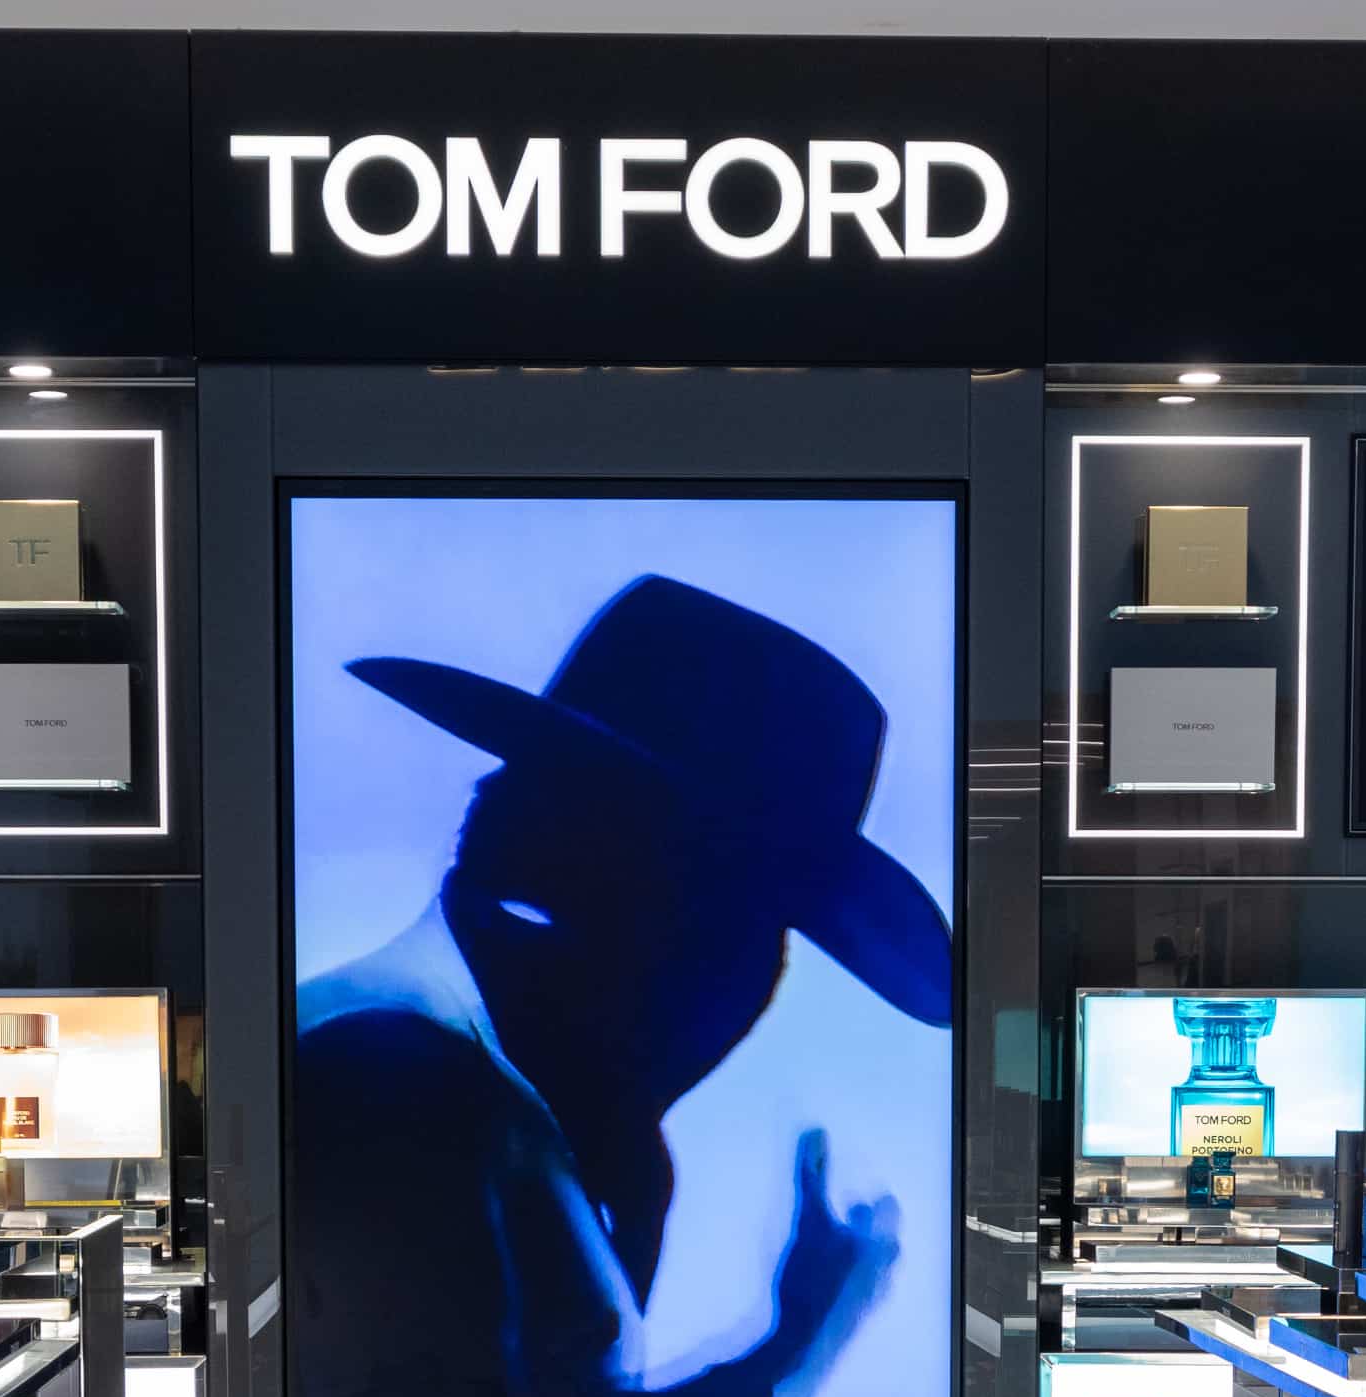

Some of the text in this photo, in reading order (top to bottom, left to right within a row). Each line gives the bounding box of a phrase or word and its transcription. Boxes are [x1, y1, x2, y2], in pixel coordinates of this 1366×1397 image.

[230, 135, 1009, 259] TOM FORD
[8, 539, 51, 566] TF
[24, 719, 67, 727] TOM FORD
[1195, 1115, 1251, 1125] TOM FORD
[1203, 1135, 1242, 1144] NEROLI
